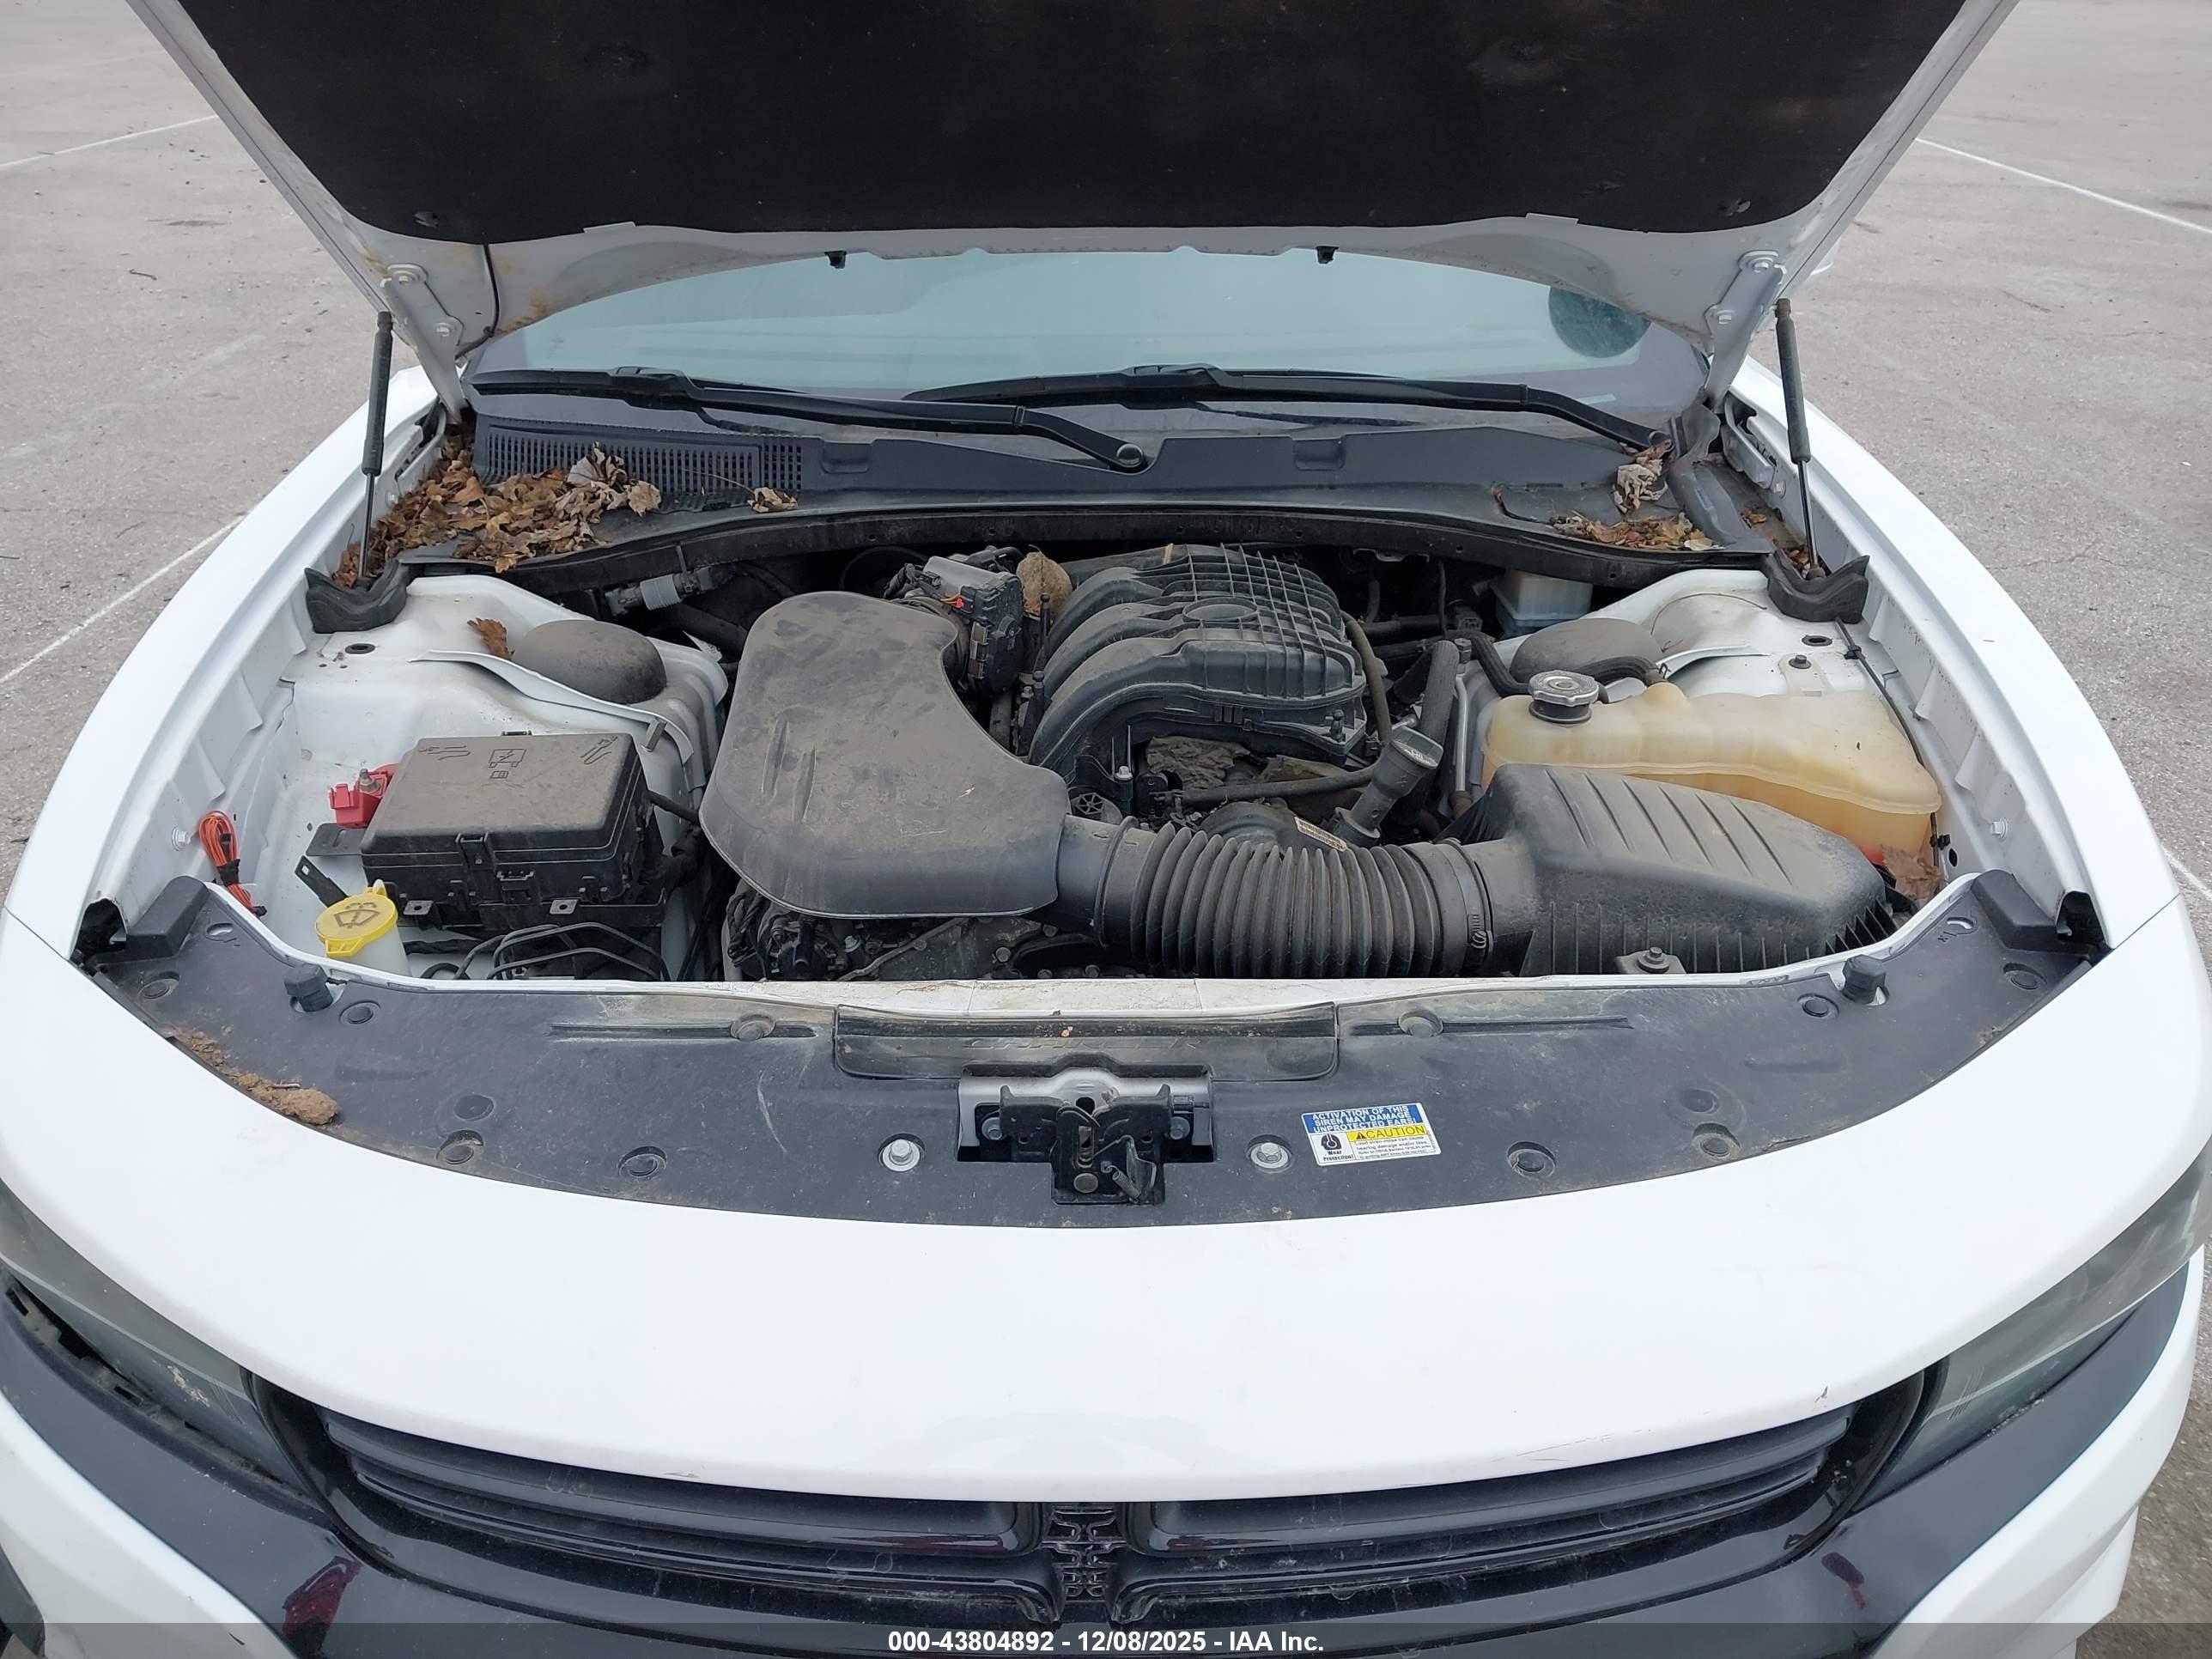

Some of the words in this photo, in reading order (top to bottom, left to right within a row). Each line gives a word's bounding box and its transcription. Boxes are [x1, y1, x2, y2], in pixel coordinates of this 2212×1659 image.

[1312, 1109, 1369, 1121] ACTIVATION
[1315, 1117, 1343, 1127] SIREN
[1346, 1115, 1366, 1124] MAY
[1369, 1111, 1412, 1121] DAMAGE
[1313, 1121, 1385, 1133] UNPROTECTED
[1388, 1117, 1417, 1127] EARS!
[1366, 1125, 1426, 1139] CAUTION
